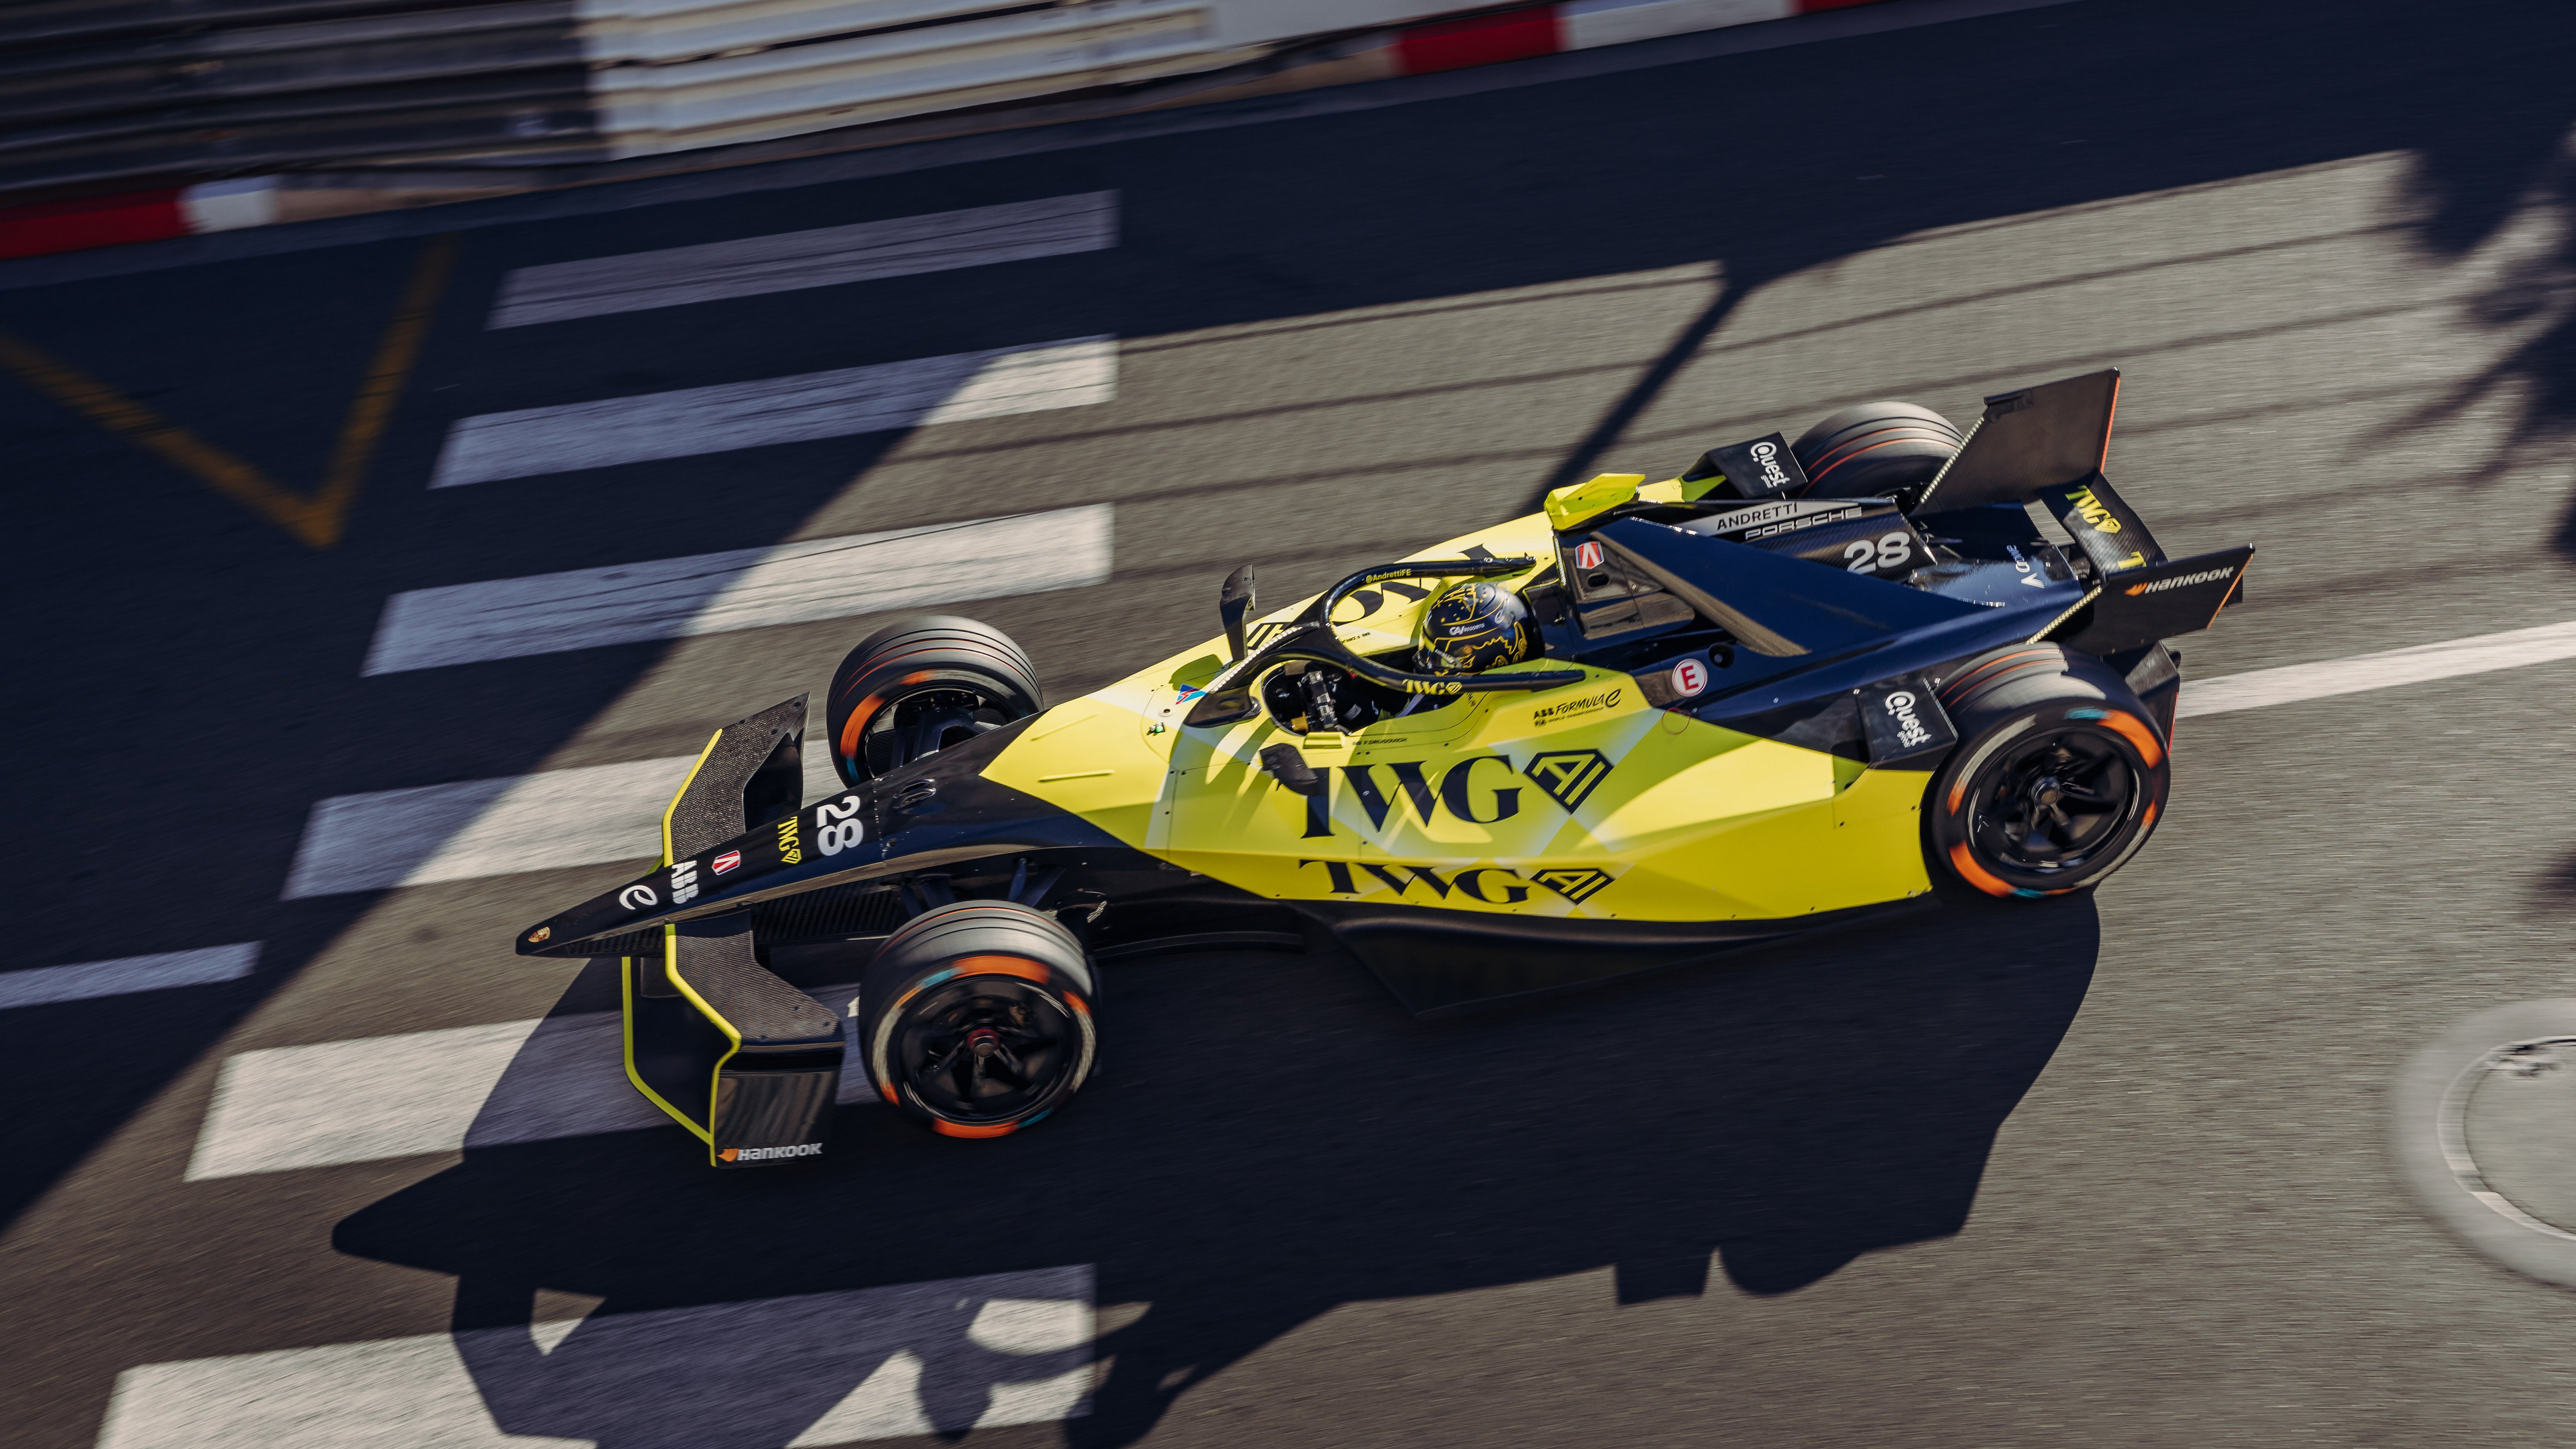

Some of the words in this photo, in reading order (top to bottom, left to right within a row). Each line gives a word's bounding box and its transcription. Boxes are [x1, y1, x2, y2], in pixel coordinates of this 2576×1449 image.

[1717, 502, 1797, 530] ANDRETTI
[1745, 507, 1862, 540] PORSCHE
[1844, 532, 1911, 574] 28
[1366, 568, 1411, 583] @AndrettiFE
[1401, 678, 1446, 695] TWG
[1680, 665, 1699, 691] E
[1533, 707, 1554, 720] ABB
[1555, 693, 1605, 716] FORMULA
[1275, 754, 1524, 839] TWG
[778, 816, 799, 851] TWG
[817, 796, 864, 856] 28
[671, 860, 699, 904] ABB
[1299, 860, 1532, 904] TWG
